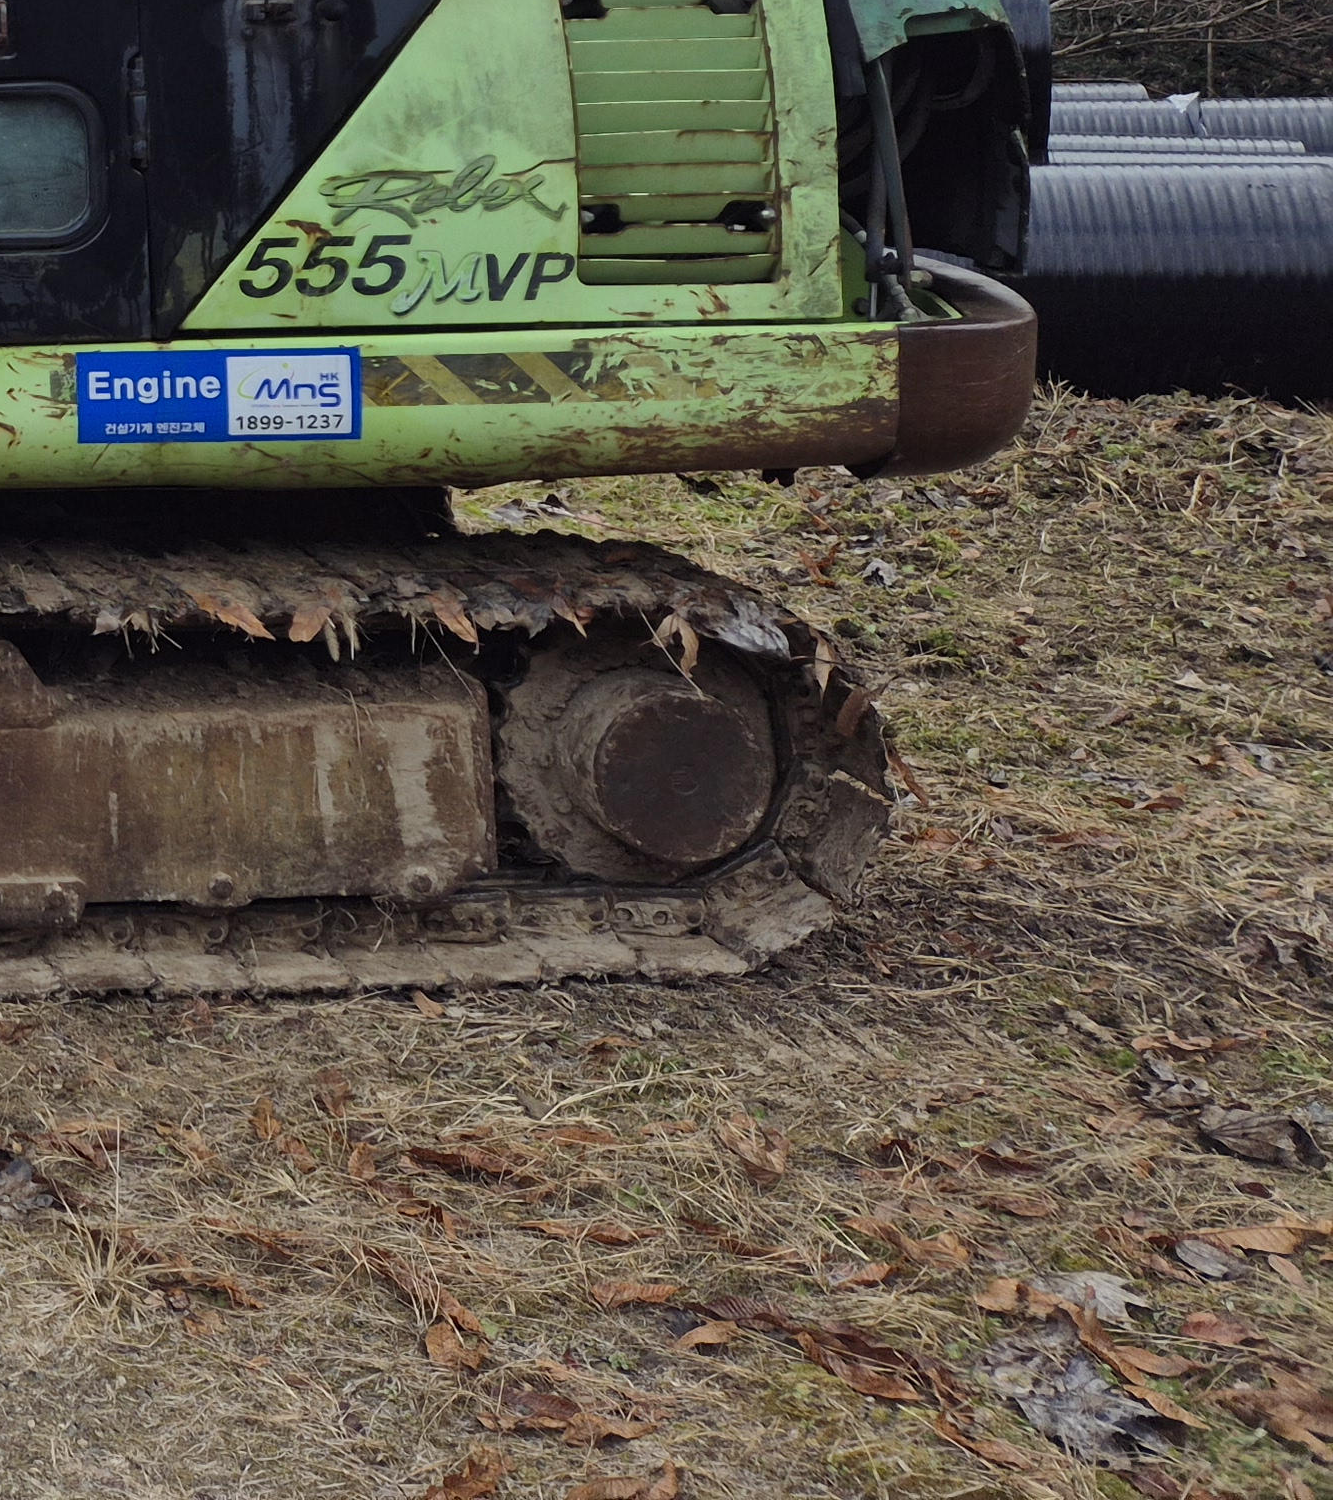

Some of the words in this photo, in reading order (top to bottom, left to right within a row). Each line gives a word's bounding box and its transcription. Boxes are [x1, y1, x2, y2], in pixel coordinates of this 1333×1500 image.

[238, 234, 413, 299] 555
[318, 371, 340, 381] HK
[87, 369, 222, 404] Engine
[105, 422, 153, 435] 건설기계
[156, 421, 206, 434] 엔진교체
[235, 414, 345, 431] 1899-1237
